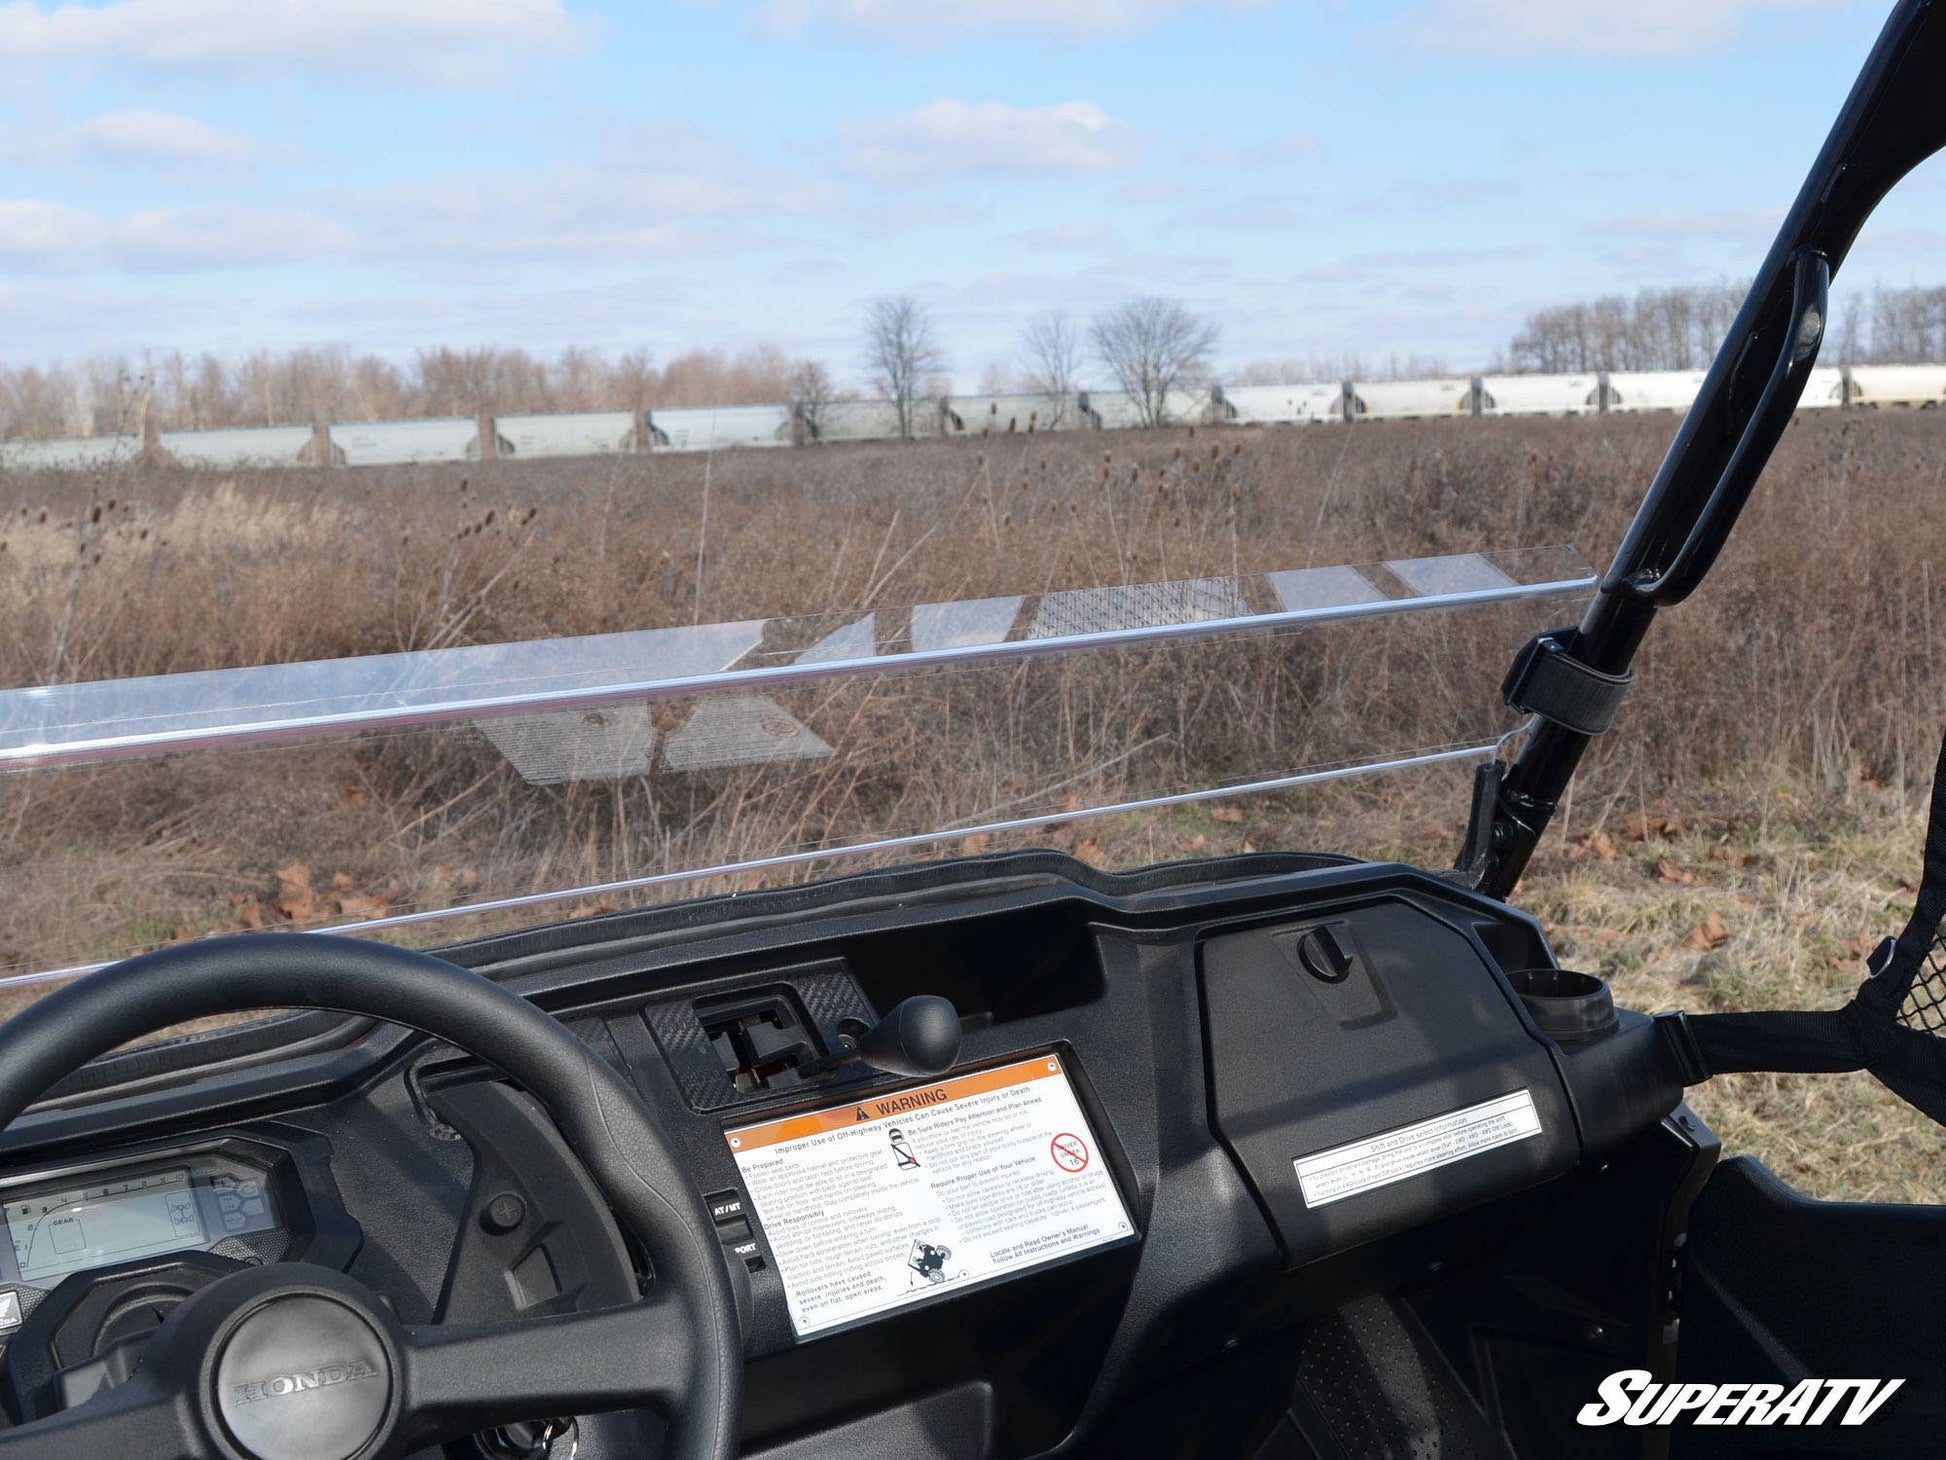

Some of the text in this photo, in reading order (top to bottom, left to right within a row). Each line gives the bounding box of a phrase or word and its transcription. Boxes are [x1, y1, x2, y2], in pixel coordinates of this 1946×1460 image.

[876, 1088, 947, 1114] WARNING
[774, 1142, 809, 1154] Improper
[810, 1138, 825, 1146] Use
[882, 1116, 913, 1128] Vehicles
[914, 1112, 930, 1120] Can
[930, 1106, 953, 1116] Cause
[954, 1100, 978, 1110] Severe
[1009, 1086, 1030, 1096] Death
[751, 1158, 783, 1170] Prepared
[763, 1210, 824, 1230] Drive Responsibly
[234, 1359, 378, 1407] HONDA
